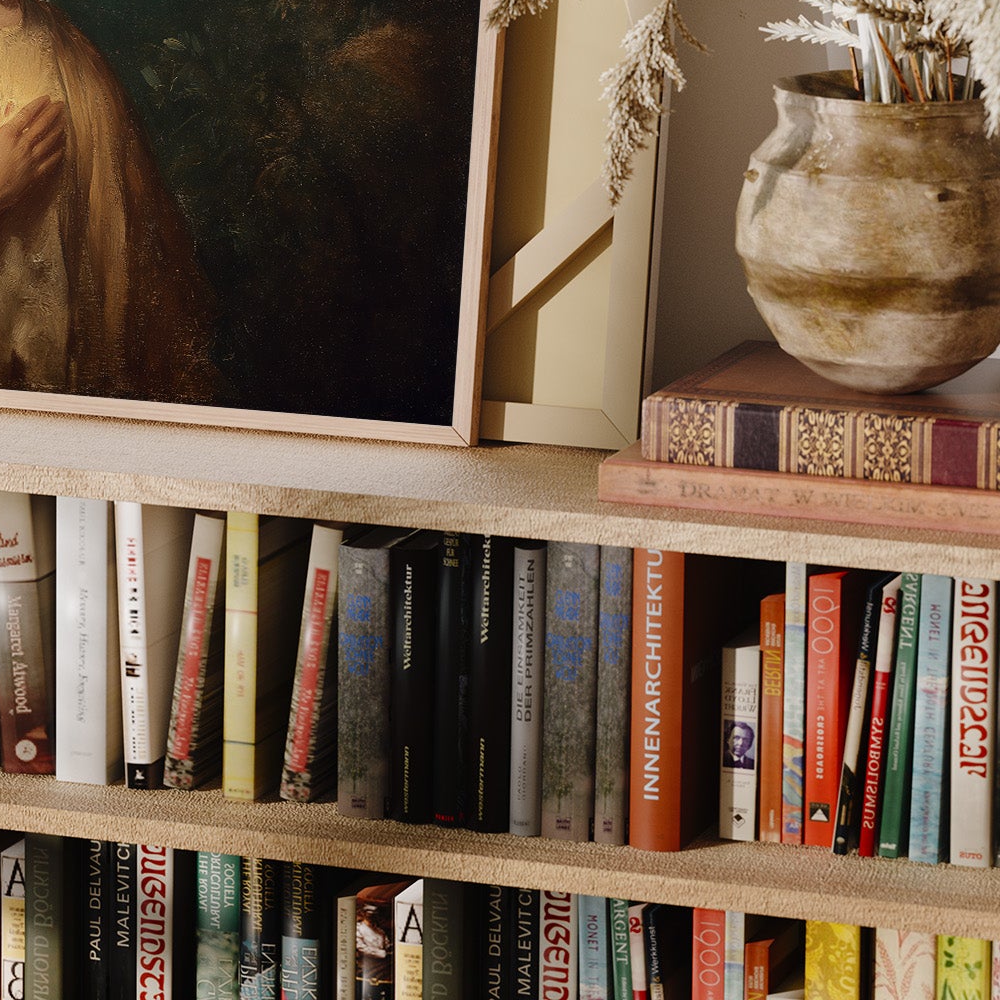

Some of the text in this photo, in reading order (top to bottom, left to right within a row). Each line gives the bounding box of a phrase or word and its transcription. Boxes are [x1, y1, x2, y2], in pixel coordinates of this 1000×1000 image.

[5, 595, 32, 714] Margaret Atwood
[402, 562, 413, 671] Weltarchitektur
[515, 572, 526, 722] DIE EINSAMKEIT
[523, 557, 535, 722] DER PRIMZAHLEN
[642, 547, 663, 801] INNENARCHITEKTU
[477, 736, 486, 821] westermann
[88, 839, 101, 961] PAUL DELVAU
[487, 885, 501, 956] DELVAU
[586, 913, 600, 952] MONET
[611, 898, 629, 966] ARGENT
[628, 916, 641, 934] 2
[648, 925, 659, 975] Werkkunst
[694, 920, 722, 987] 1900
